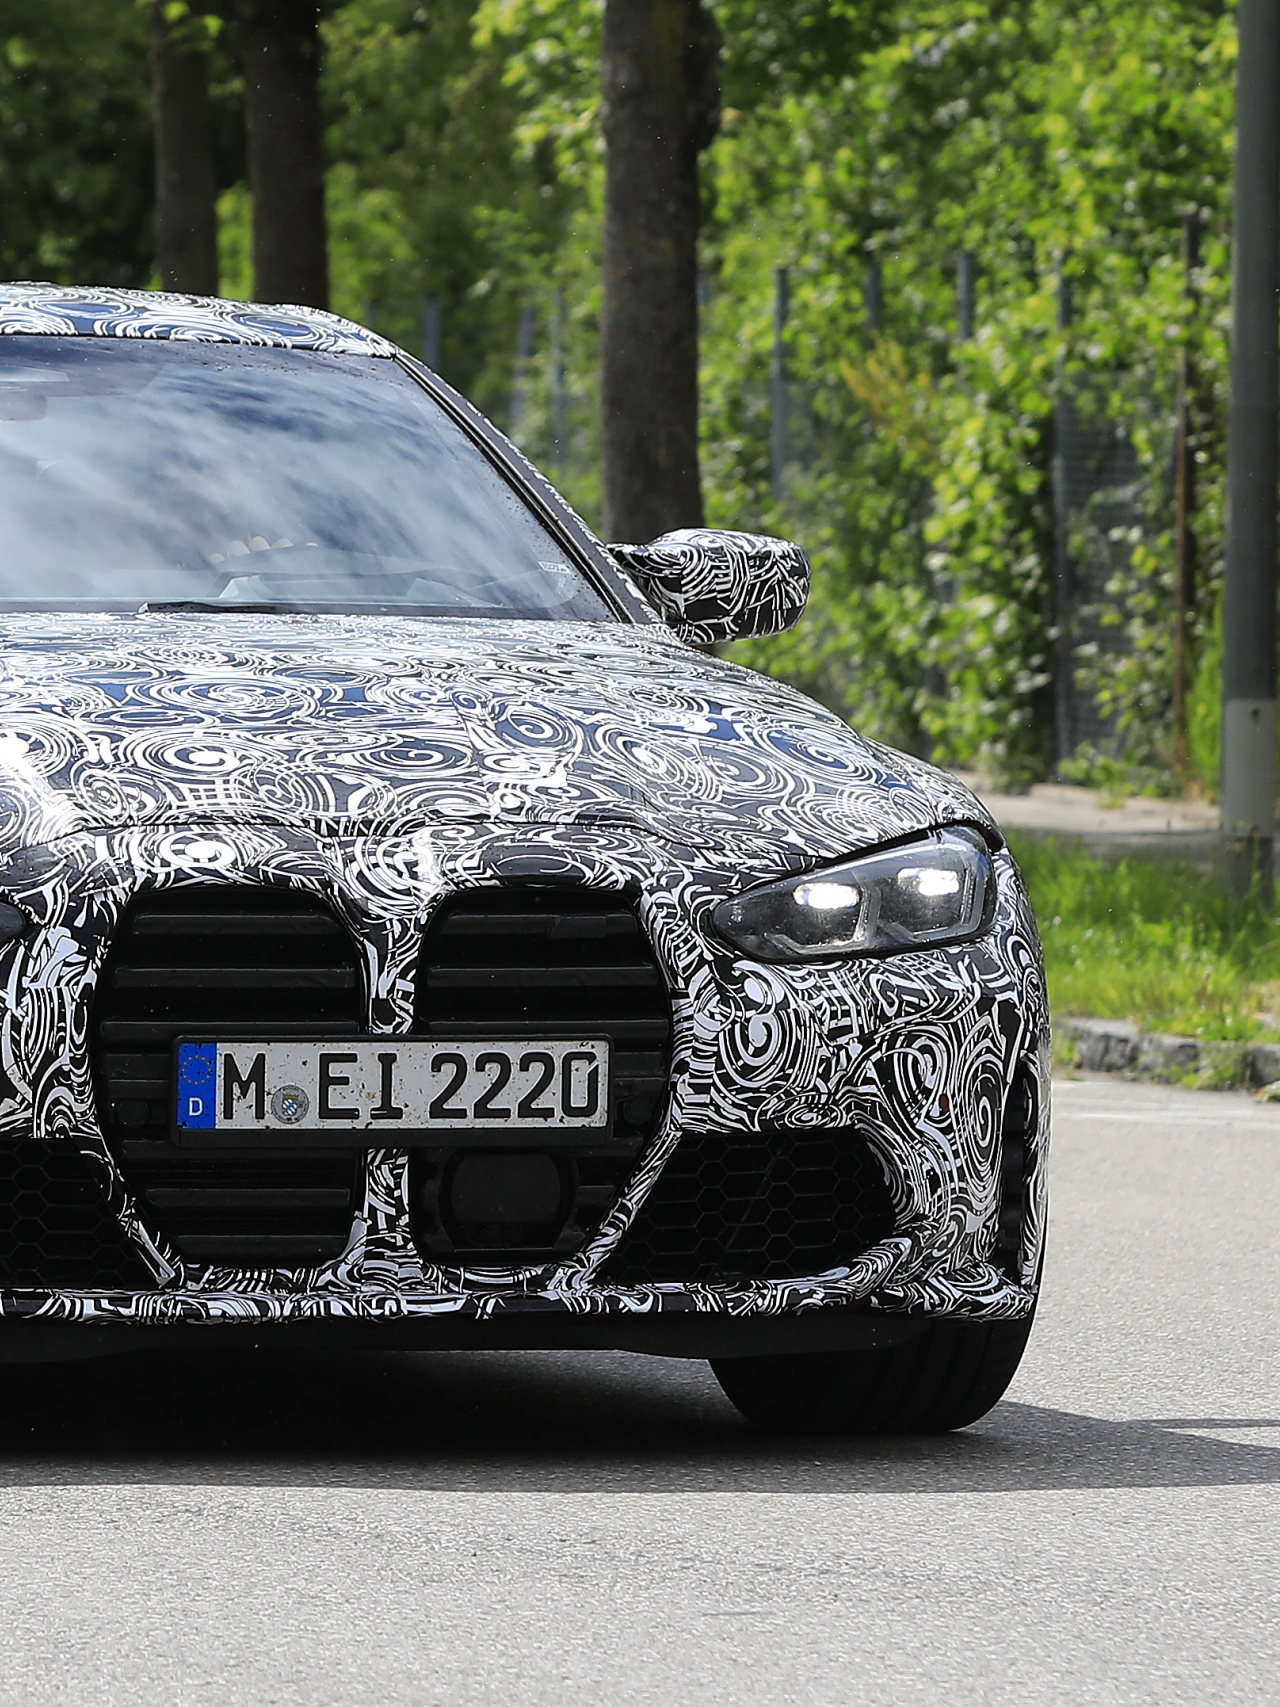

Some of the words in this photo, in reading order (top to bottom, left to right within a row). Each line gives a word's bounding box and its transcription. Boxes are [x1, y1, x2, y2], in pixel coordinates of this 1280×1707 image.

[188, 1097, 204, 1116] D
[223, 1052, 266, 1120] M
[318, 1052, 404, 1120] EI
[429, 1051, 599, 1119] 2220
